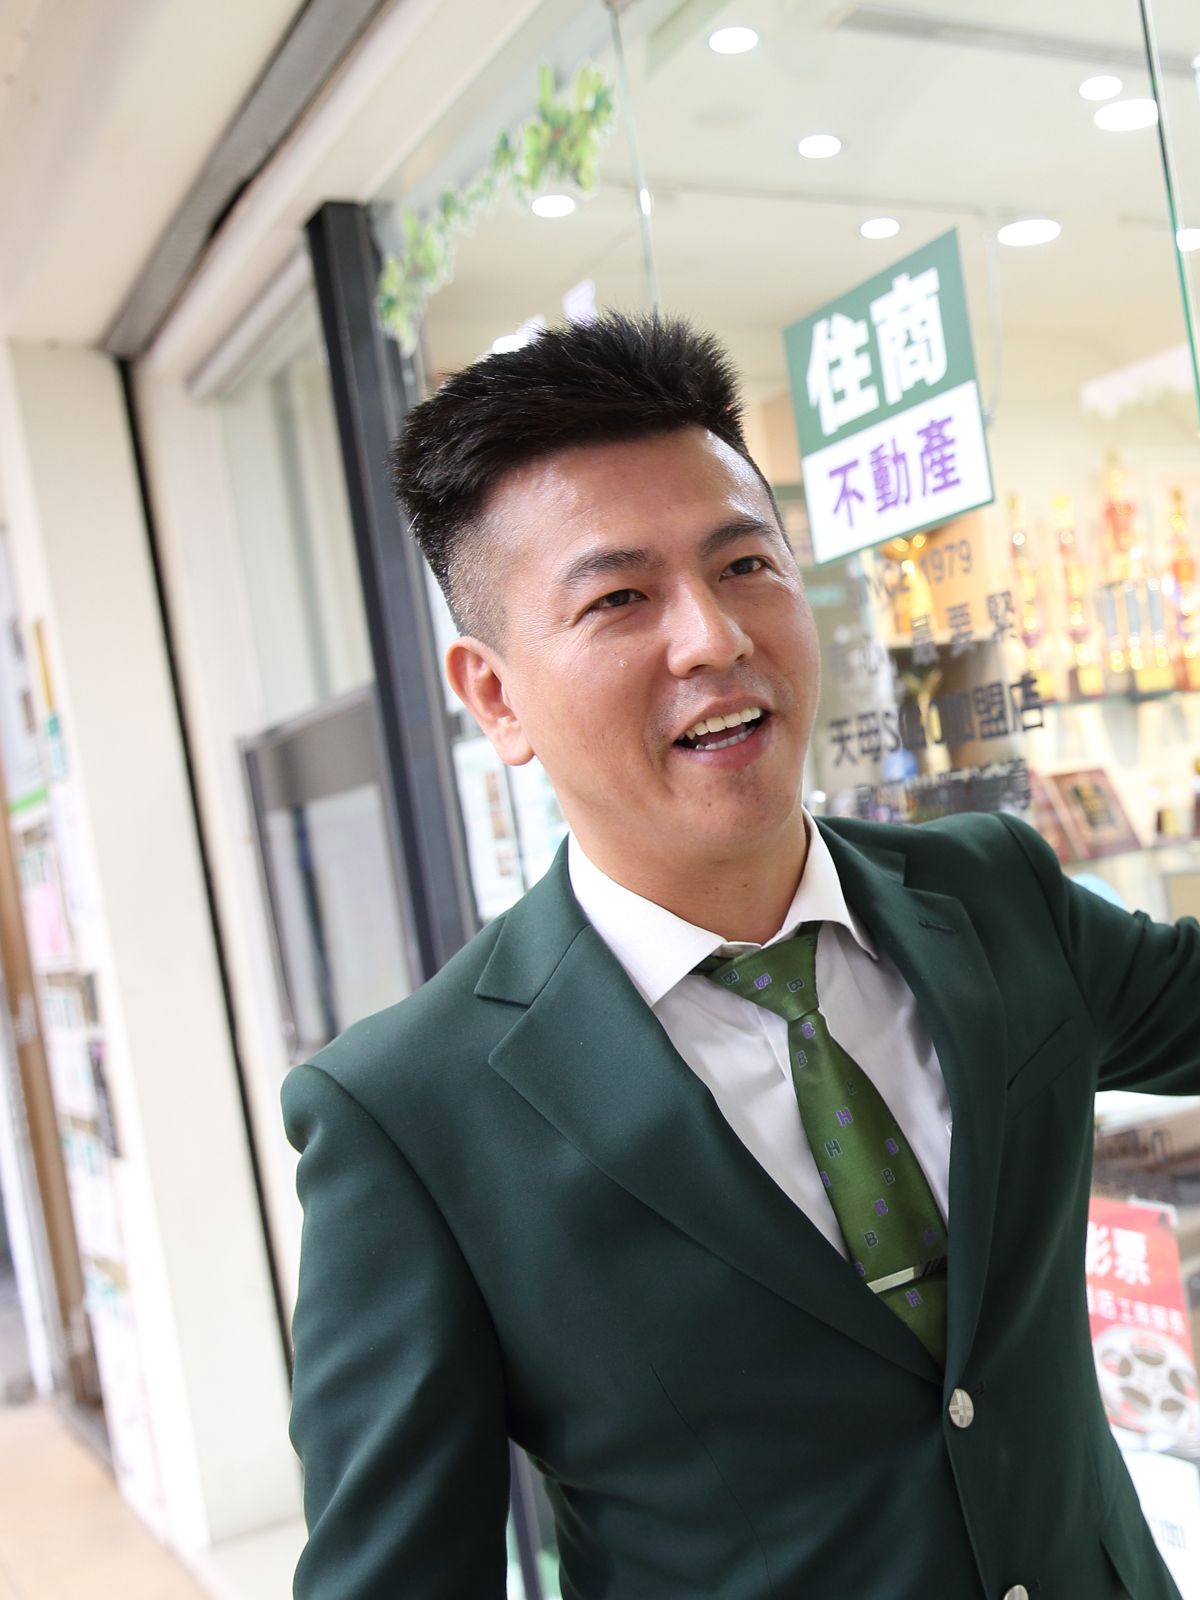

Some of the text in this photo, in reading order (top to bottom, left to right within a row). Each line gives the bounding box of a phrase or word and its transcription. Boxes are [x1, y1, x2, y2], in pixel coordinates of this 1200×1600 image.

[806, 267, 947, 436] 住商
[829, 416, 961, 529] 不動產
